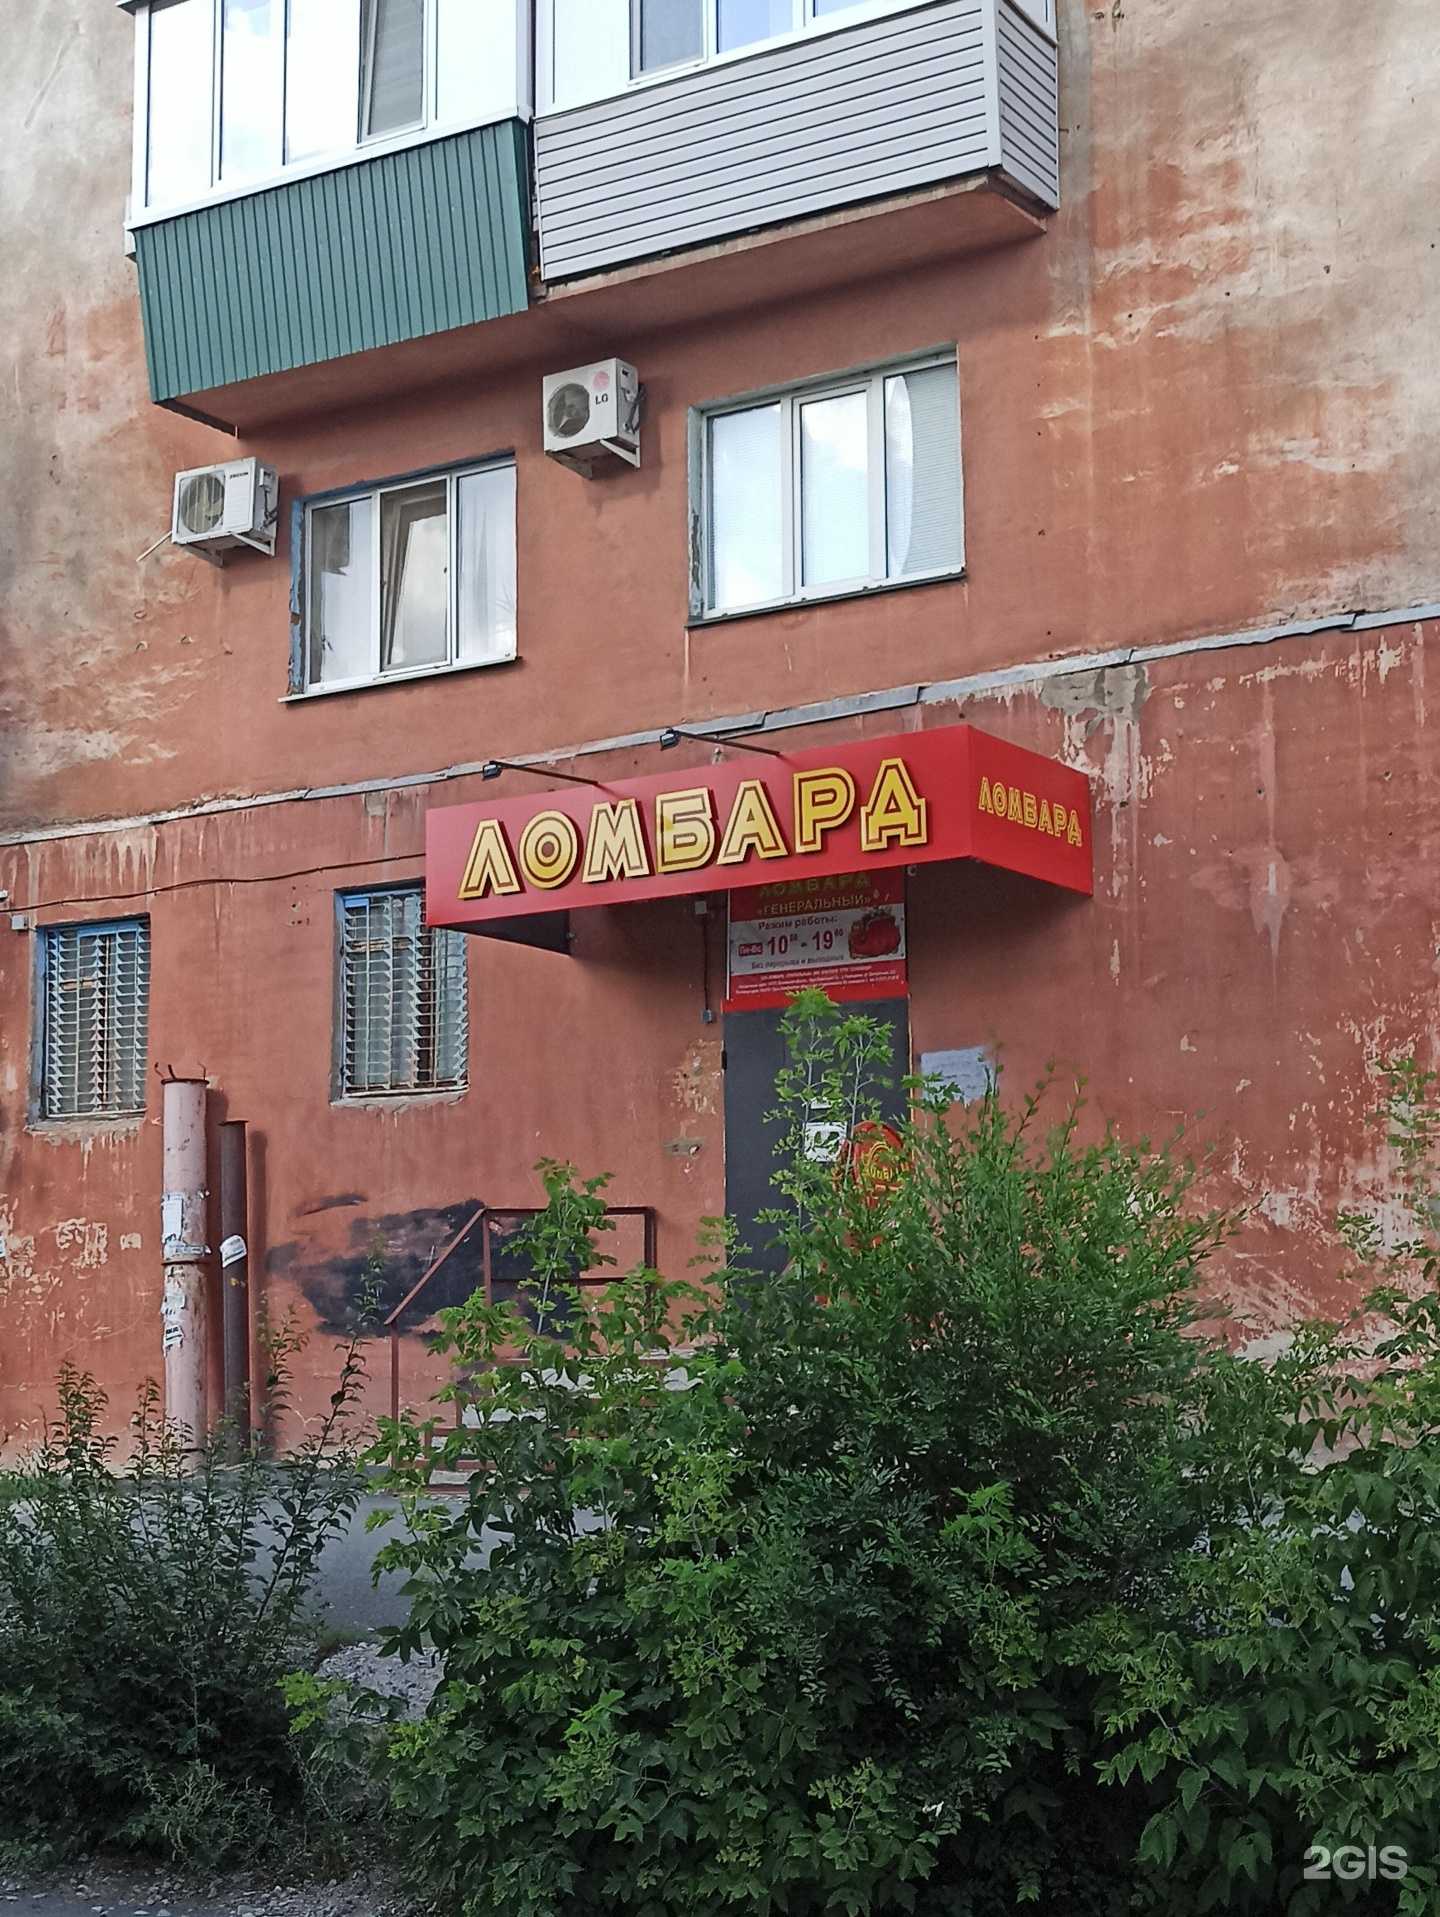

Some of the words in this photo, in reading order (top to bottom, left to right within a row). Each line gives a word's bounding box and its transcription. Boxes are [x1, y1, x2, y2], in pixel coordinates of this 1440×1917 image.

[595, 393, 608, 405] LG
[457, 757, 927, 899] ЛОМБАРД
[978, 776, 1082, 847] ЛОМБАРД
